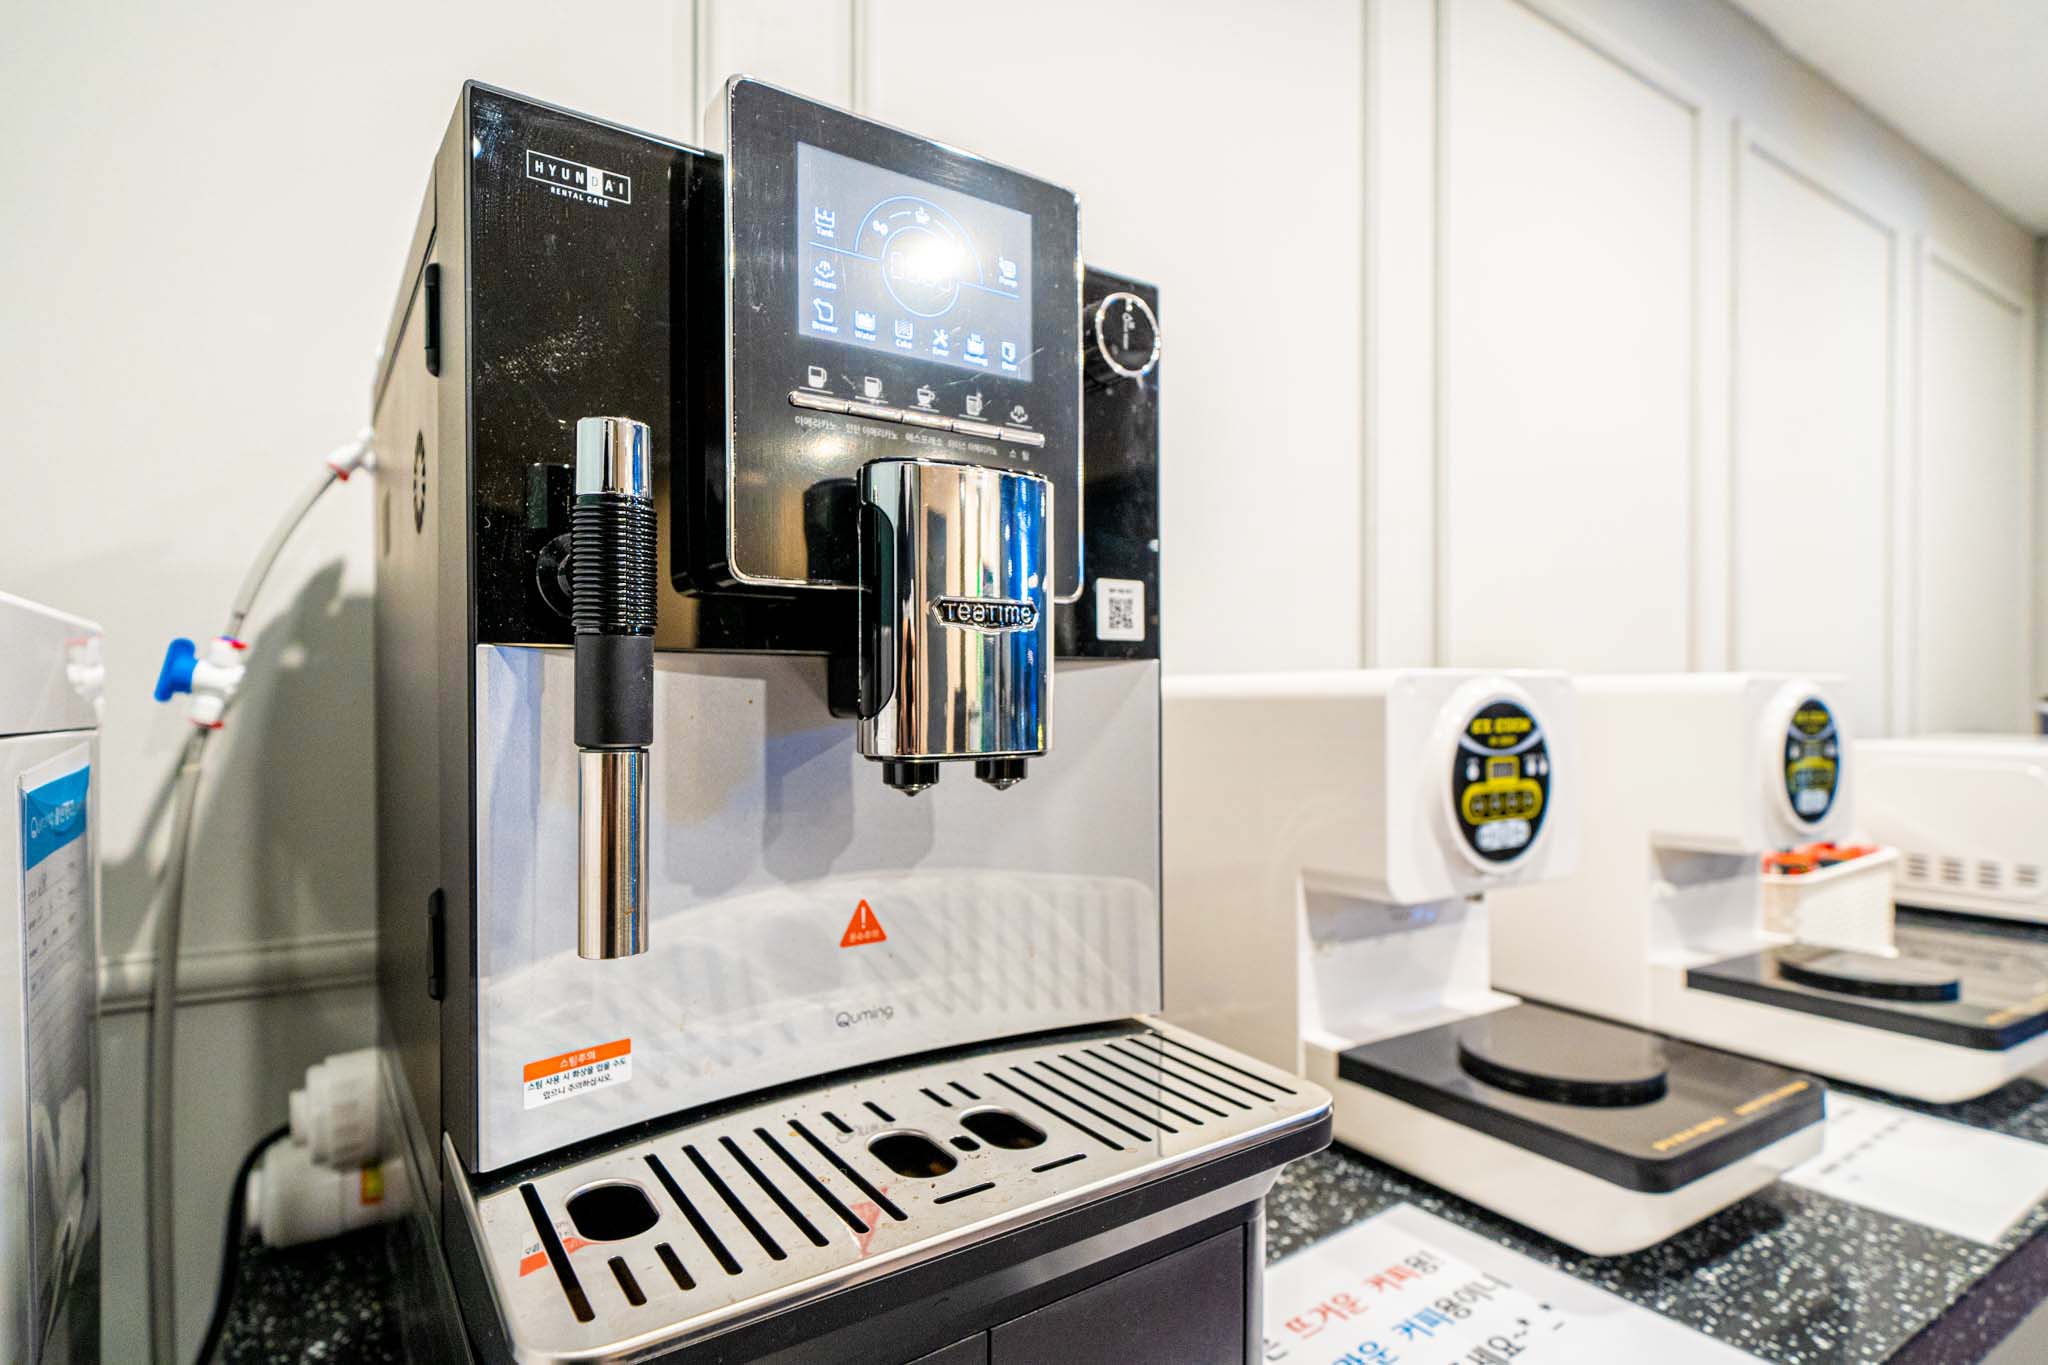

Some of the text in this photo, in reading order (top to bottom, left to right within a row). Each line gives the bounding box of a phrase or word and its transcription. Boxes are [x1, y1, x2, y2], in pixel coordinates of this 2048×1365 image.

[534, 160, 624, 195] HYUNDAI
[550, 187, 609, 207] RENTAL CARE
[560, 1050, 597, 1069] 스팀주의
[1285, 1292, 1369, 1339] 뜨거운
[1391, 1271, 1513, 1341] 커피용이니
